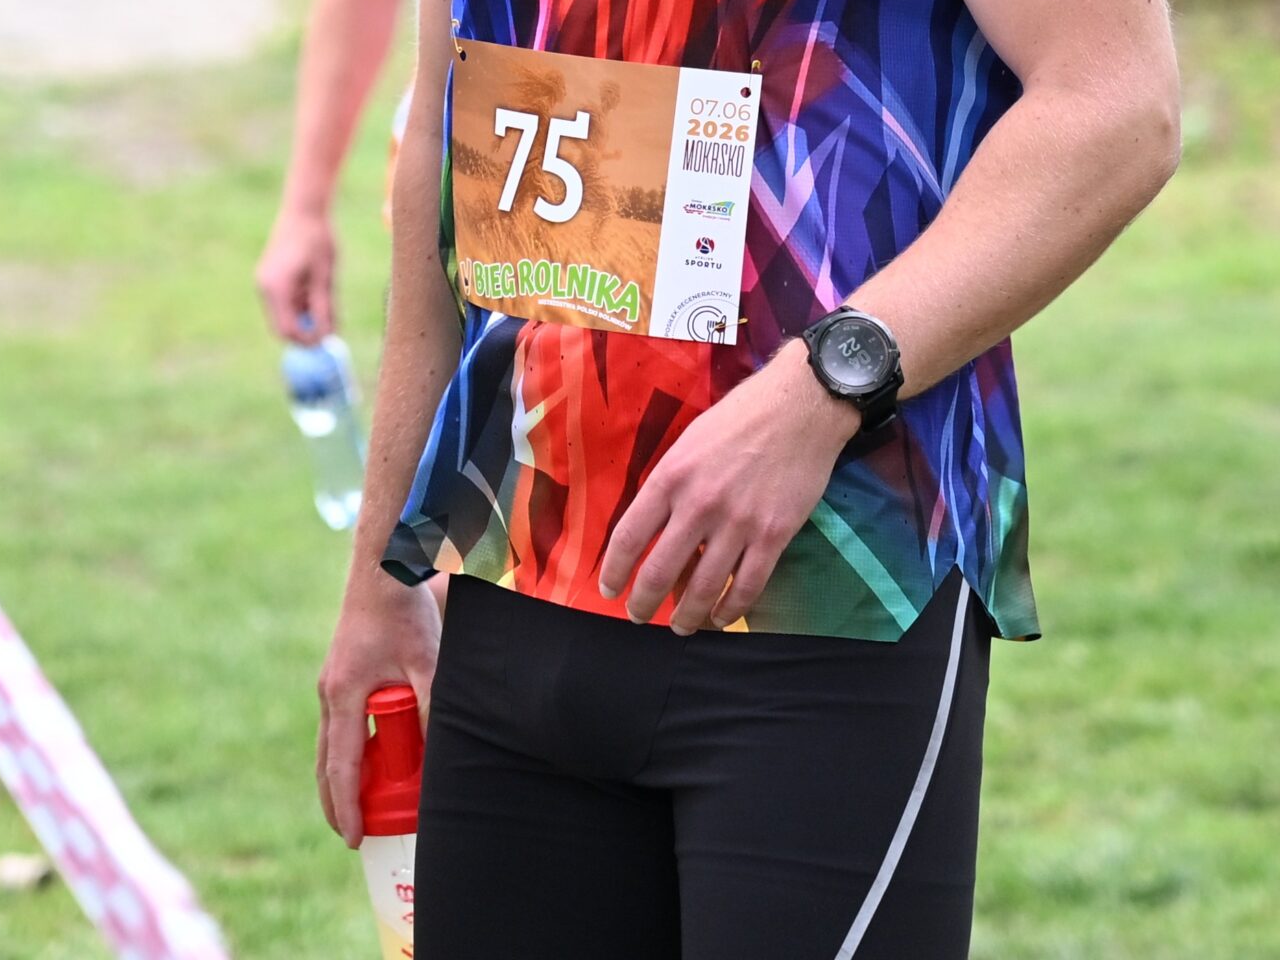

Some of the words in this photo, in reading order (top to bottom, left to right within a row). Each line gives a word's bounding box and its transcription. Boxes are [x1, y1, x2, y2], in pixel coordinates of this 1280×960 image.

[690, 98, 752, 121] 07.06
[687, 119, 750, 142] 2026
[494, 107, 591, 223] 75
[682, 139, 745, 178] MOKRSKO
[690, 203, 728, 213] MOKRSKO
[685, 259, 722, 270] SPORTU
[473, 260, 516, 299] BIEG
[517, 258, 640, 322] ROLNIKA
